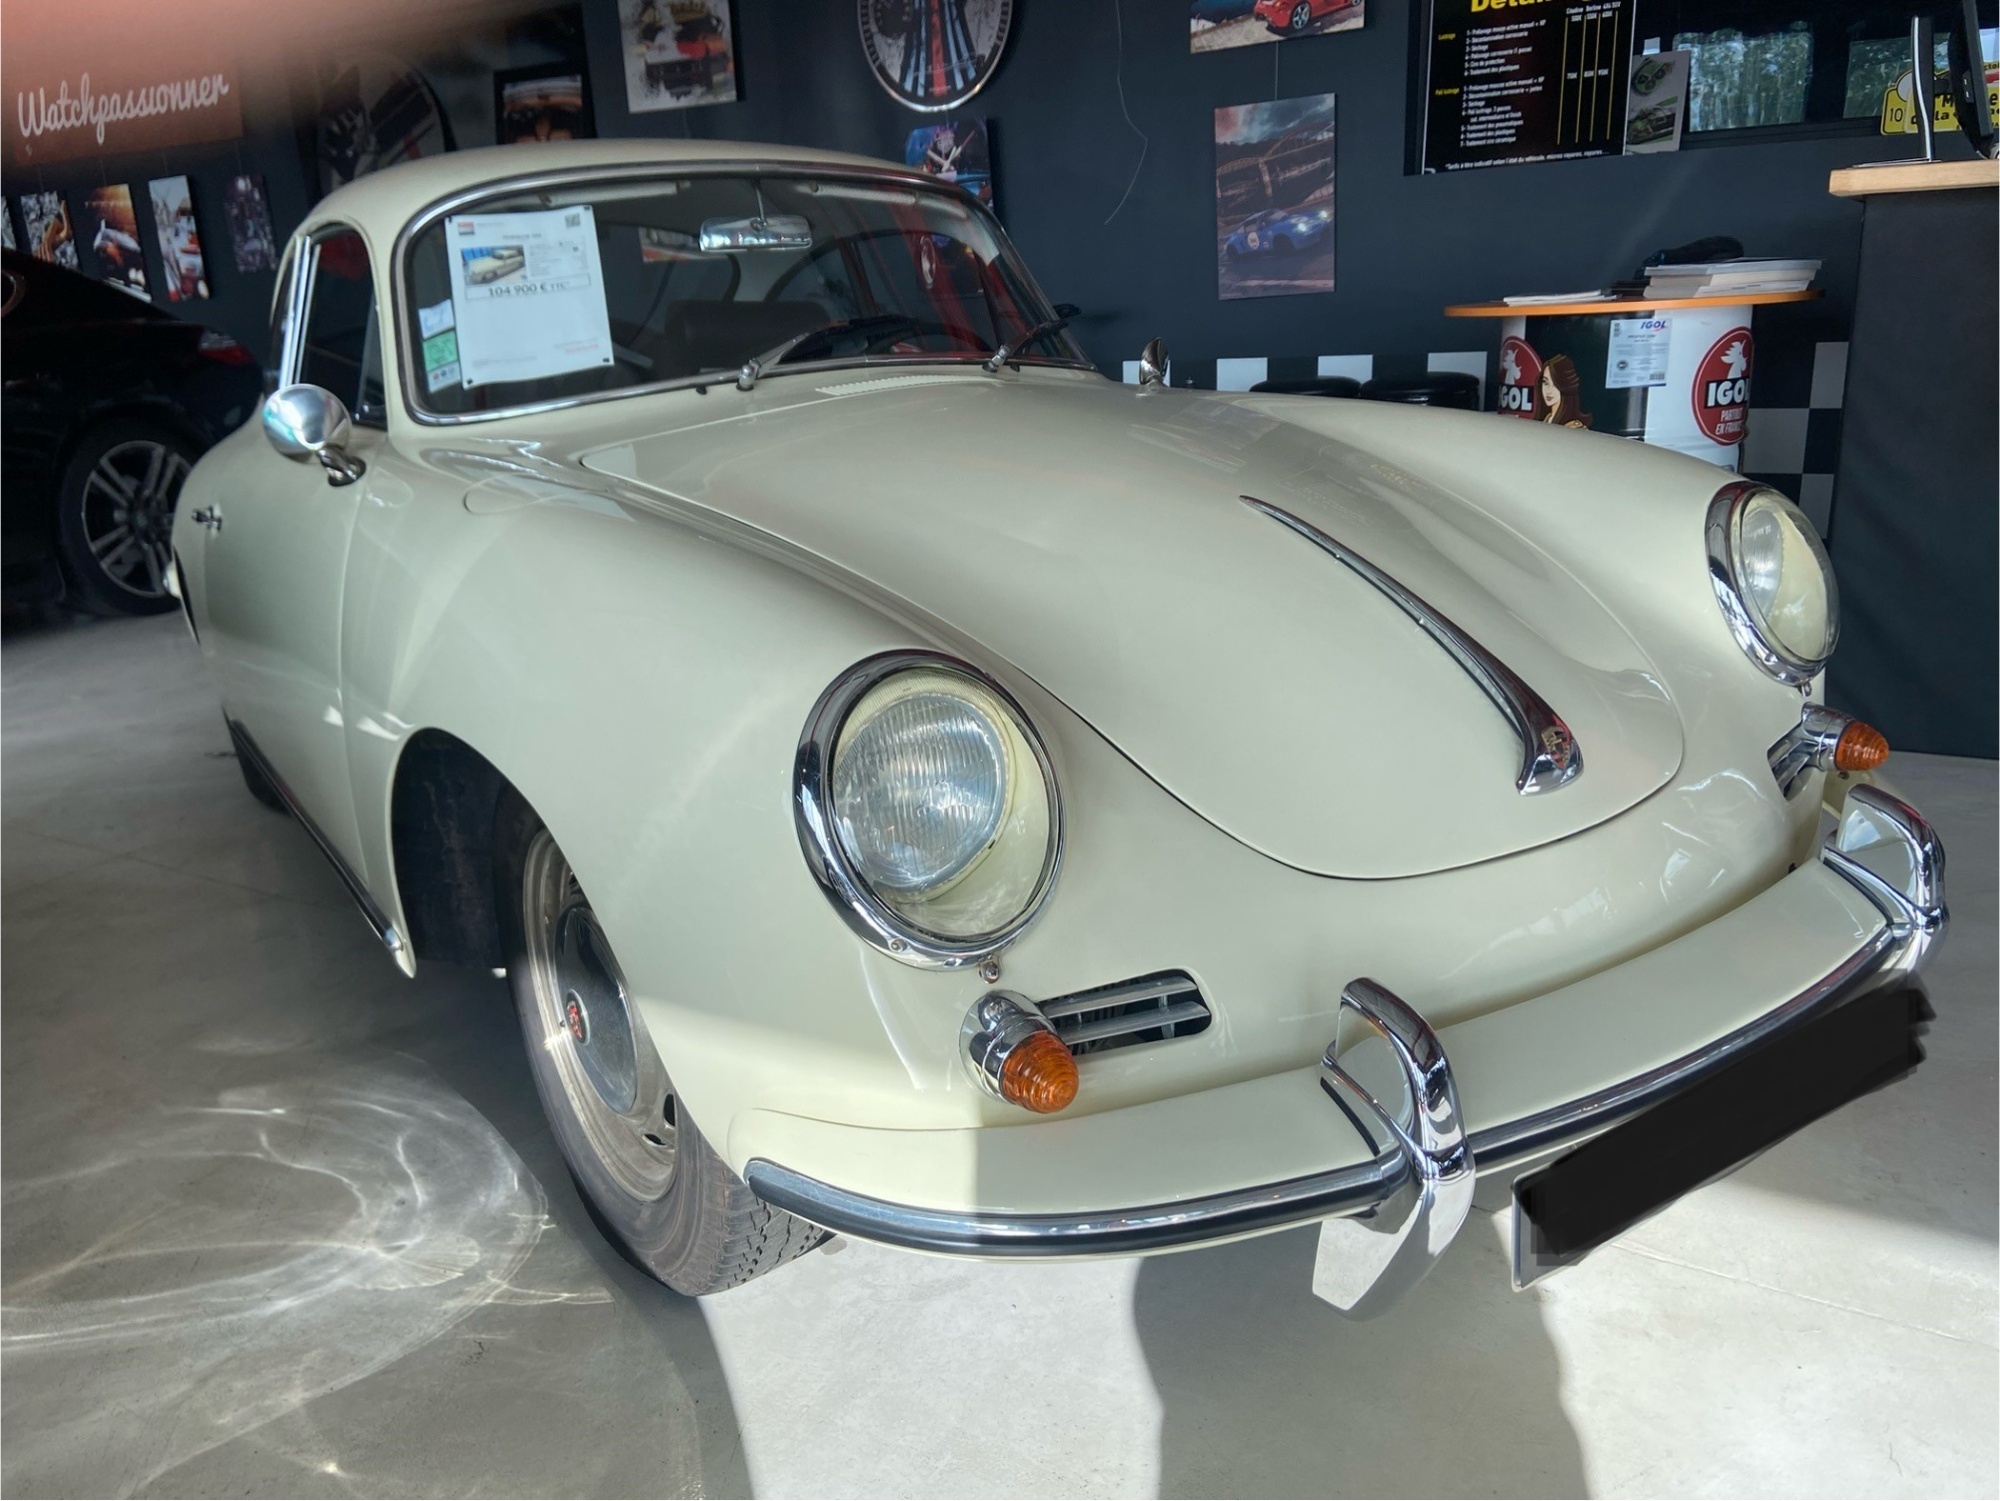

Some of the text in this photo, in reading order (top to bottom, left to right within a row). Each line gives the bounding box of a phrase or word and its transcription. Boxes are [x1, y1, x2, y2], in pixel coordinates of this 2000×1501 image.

[488, 286, 511, 298] 104
[514, 282, 538, 296] 900
[540, 281, 547, 292] €
[1640, 320, 1666, 329] IGOL
[1499, 385, 1532, 411] GOL
